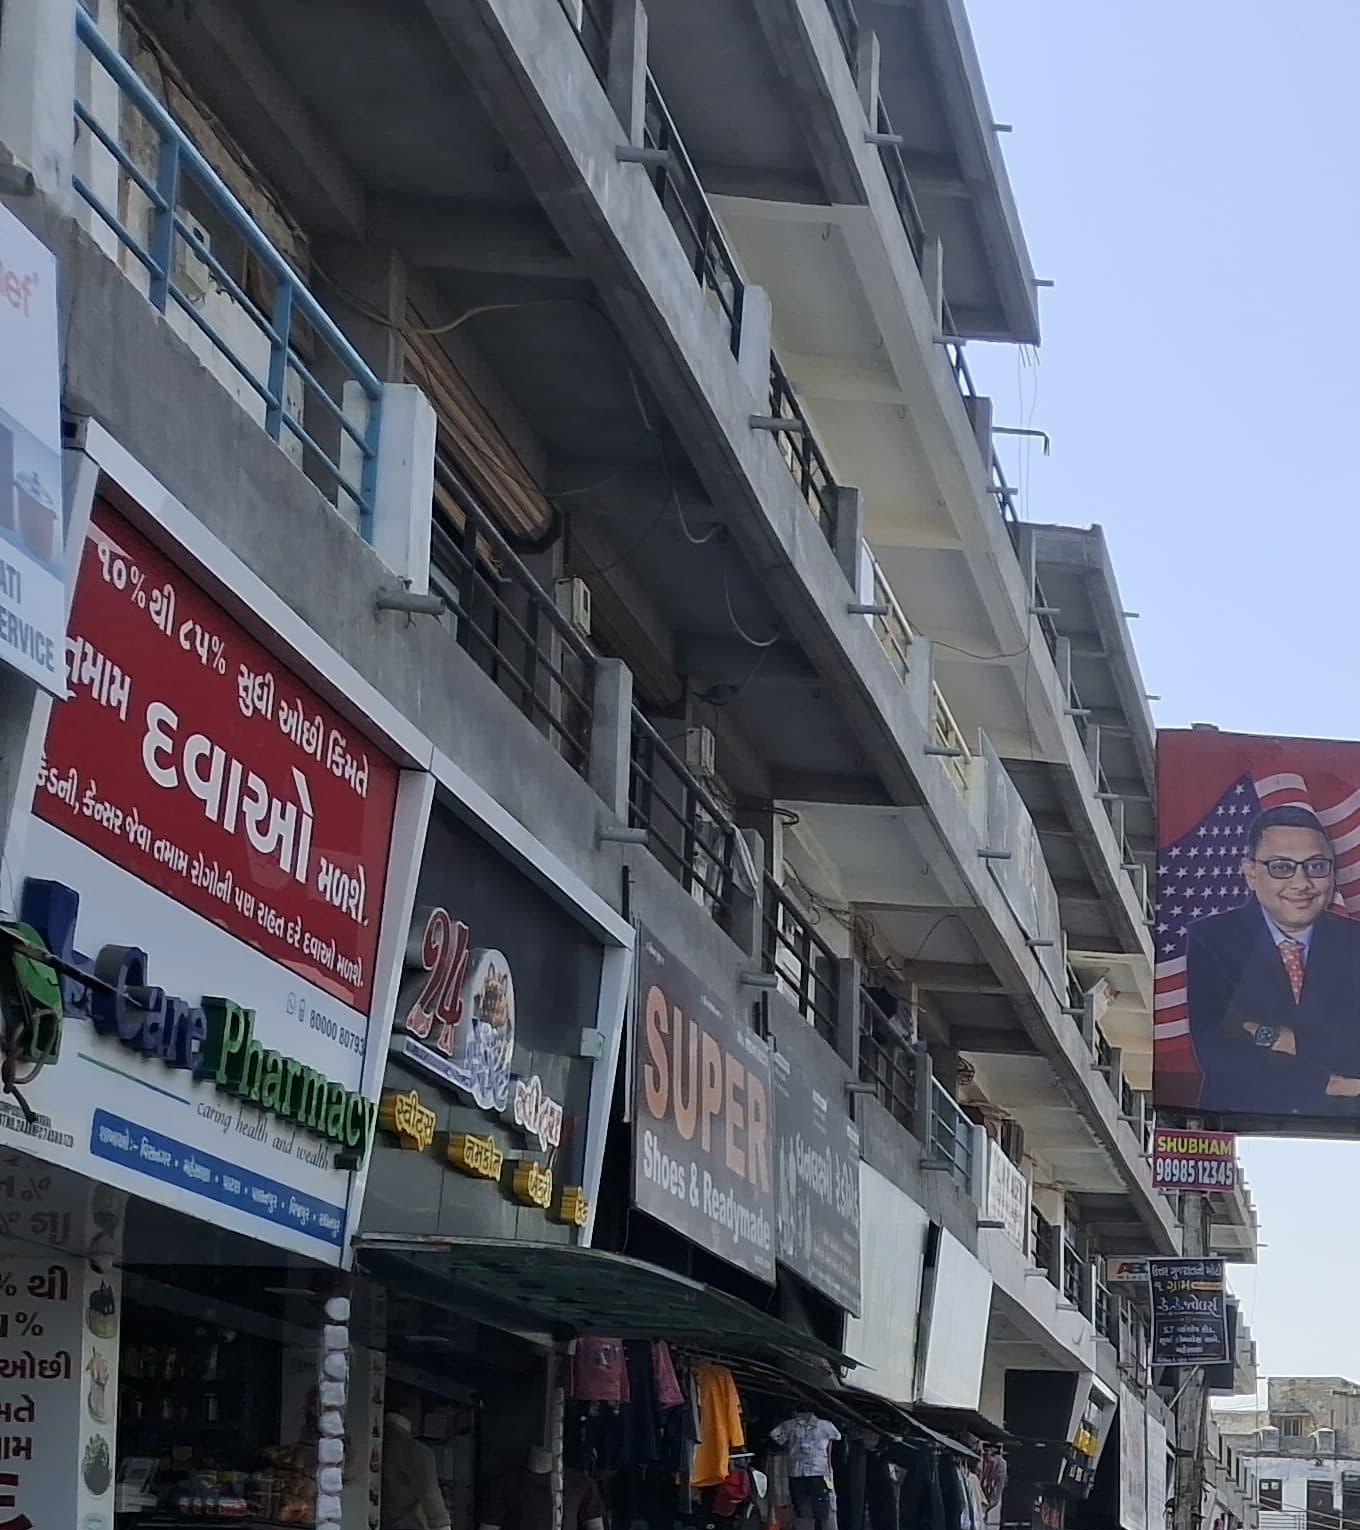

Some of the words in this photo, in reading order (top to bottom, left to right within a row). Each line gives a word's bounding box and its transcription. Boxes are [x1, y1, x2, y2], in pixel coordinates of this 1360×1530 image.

[149, 584, 176, 636] થી
[237, 663, 274, 721] સુધી
[278, 698, 324, 762] ઓછી
[82, 776, 123, 836] કેન્સર
[125, 805, 151, 853] જેવા
[153, 837, 188, 877] તમામ
[234, 885, 255, 919] પણ
[257, 901, 285, 940] રાહત
[303, 930, 334, 973] દવાઓ
[142, 701, 313, 884] દવાઓ
[197, 1101, 232, 1136] caring
[235, 1108, 268, 1145] health
[271, 1128, 293, 1156] and
[294, 1138, 330, 1172] wealth
[202, 996, 376, 1165] Pharmacy
[643, 985, 771, 1193] SUPER
[1157, 1135, 1233, 1156] SHUBHAM
[643, 1130, 686, 1202] Shoes
[687, 1161, 700, 1209] &
[702, 1168, 771, 1249] Readymade
[1155, 1158, 1197, 1184] 98985
[1197, 1161, 1233, 1186] 12345
